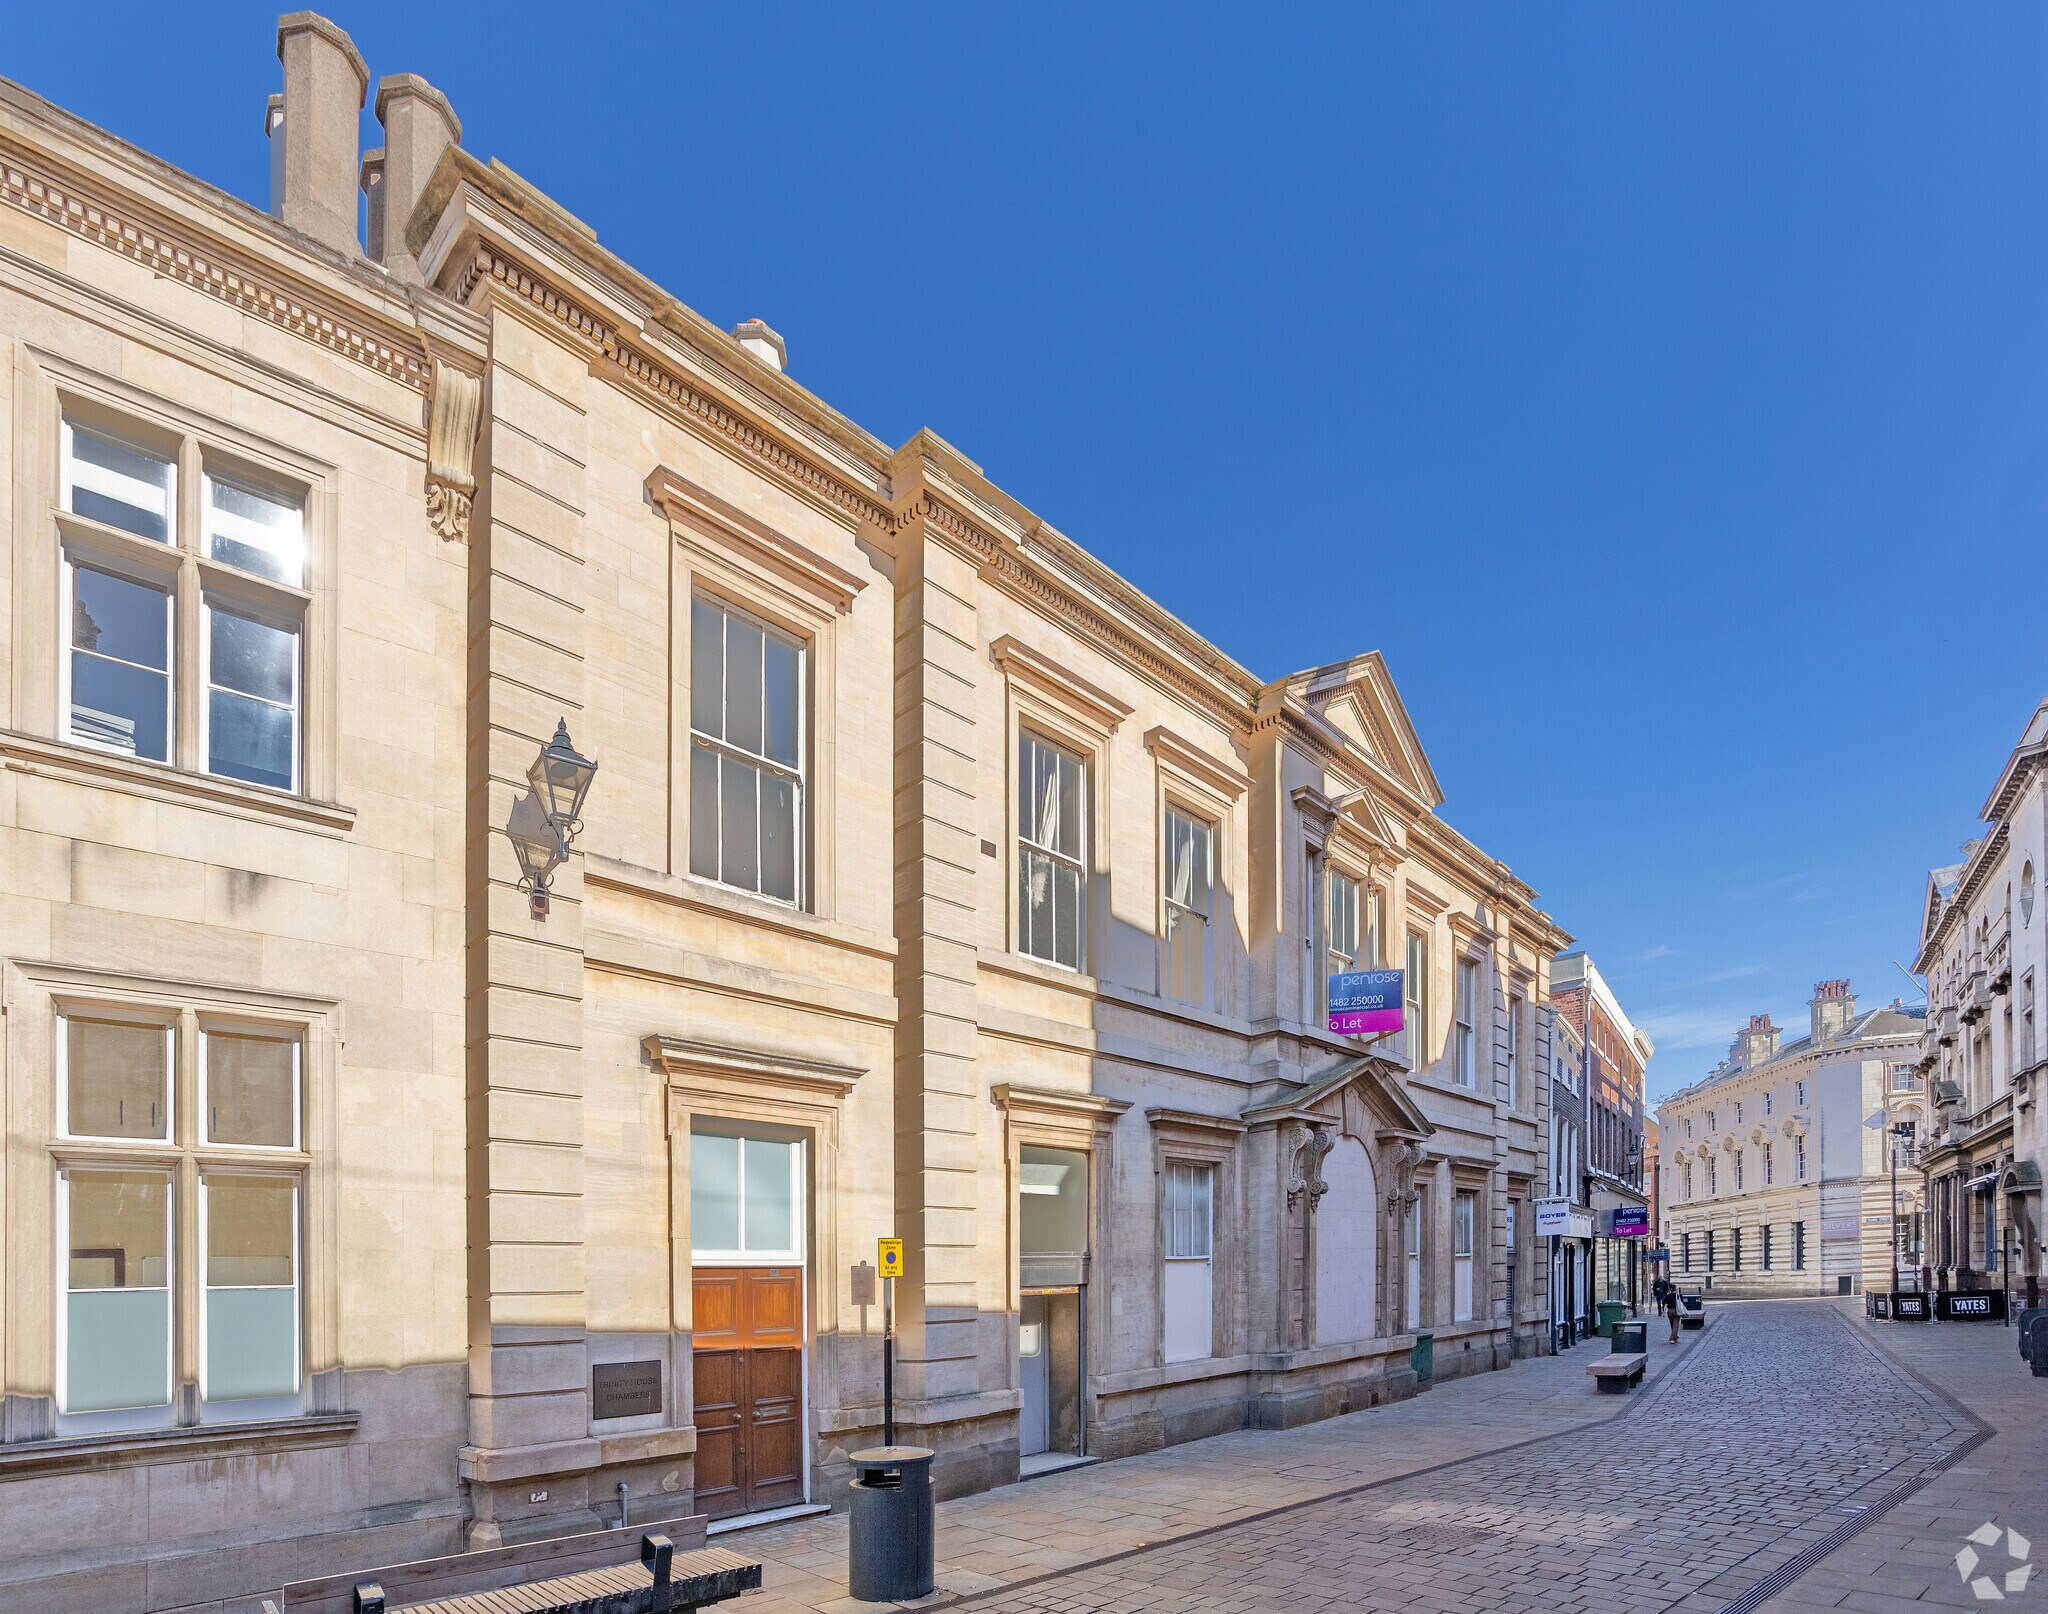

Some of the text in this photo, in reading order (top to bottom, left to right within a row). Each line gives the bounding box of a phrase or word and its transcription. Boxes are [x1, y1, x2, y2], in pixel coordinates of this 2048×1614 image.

[1342, 972, 1400, 990] penrose
[1351, 995, 1384, 1006] 250000
[1342, 1017, 1362, 1029] Let
[1622, 1207, 1647, 1217] penrose
[1823, 1221, 1857, 1230] SILVERS
[1901, 1301, 1920, 1311] YATES
[1954, 1300, 1987, 1311] YATES
[598, 1377, 658, 1389] TRINITY HOUSE
[606, 1390, 650, 1401] CHAMBERS
